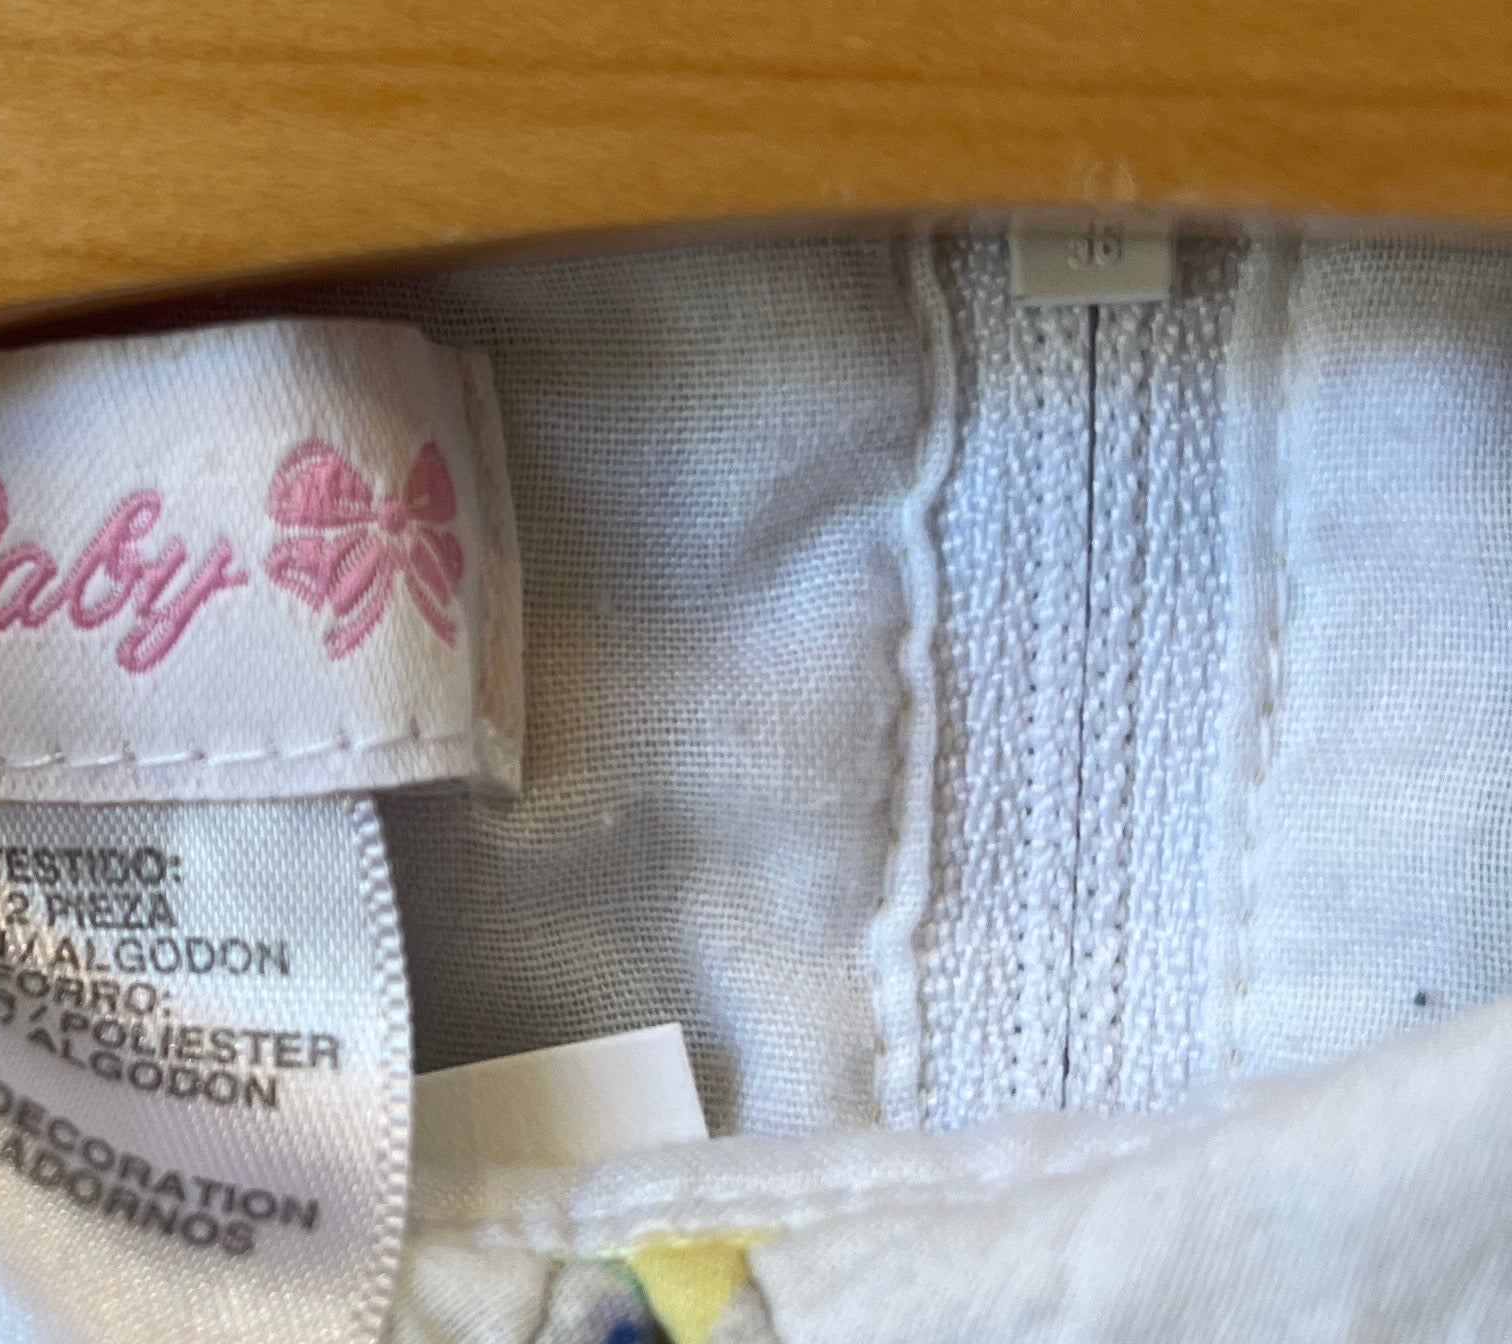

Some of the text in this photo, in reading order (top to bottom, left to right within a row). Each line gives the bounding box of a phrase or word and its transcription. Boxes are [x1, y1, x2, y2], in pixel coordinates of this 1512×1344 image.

[3, 889, 30, 925] 2
[44, 888, 179, 931] PIEZA
[49, 935, 291, 976] ALGODON
[57, 1010, 341, 1070] POLIESTER
[24, 1025, 281, 1109] ALGODON
